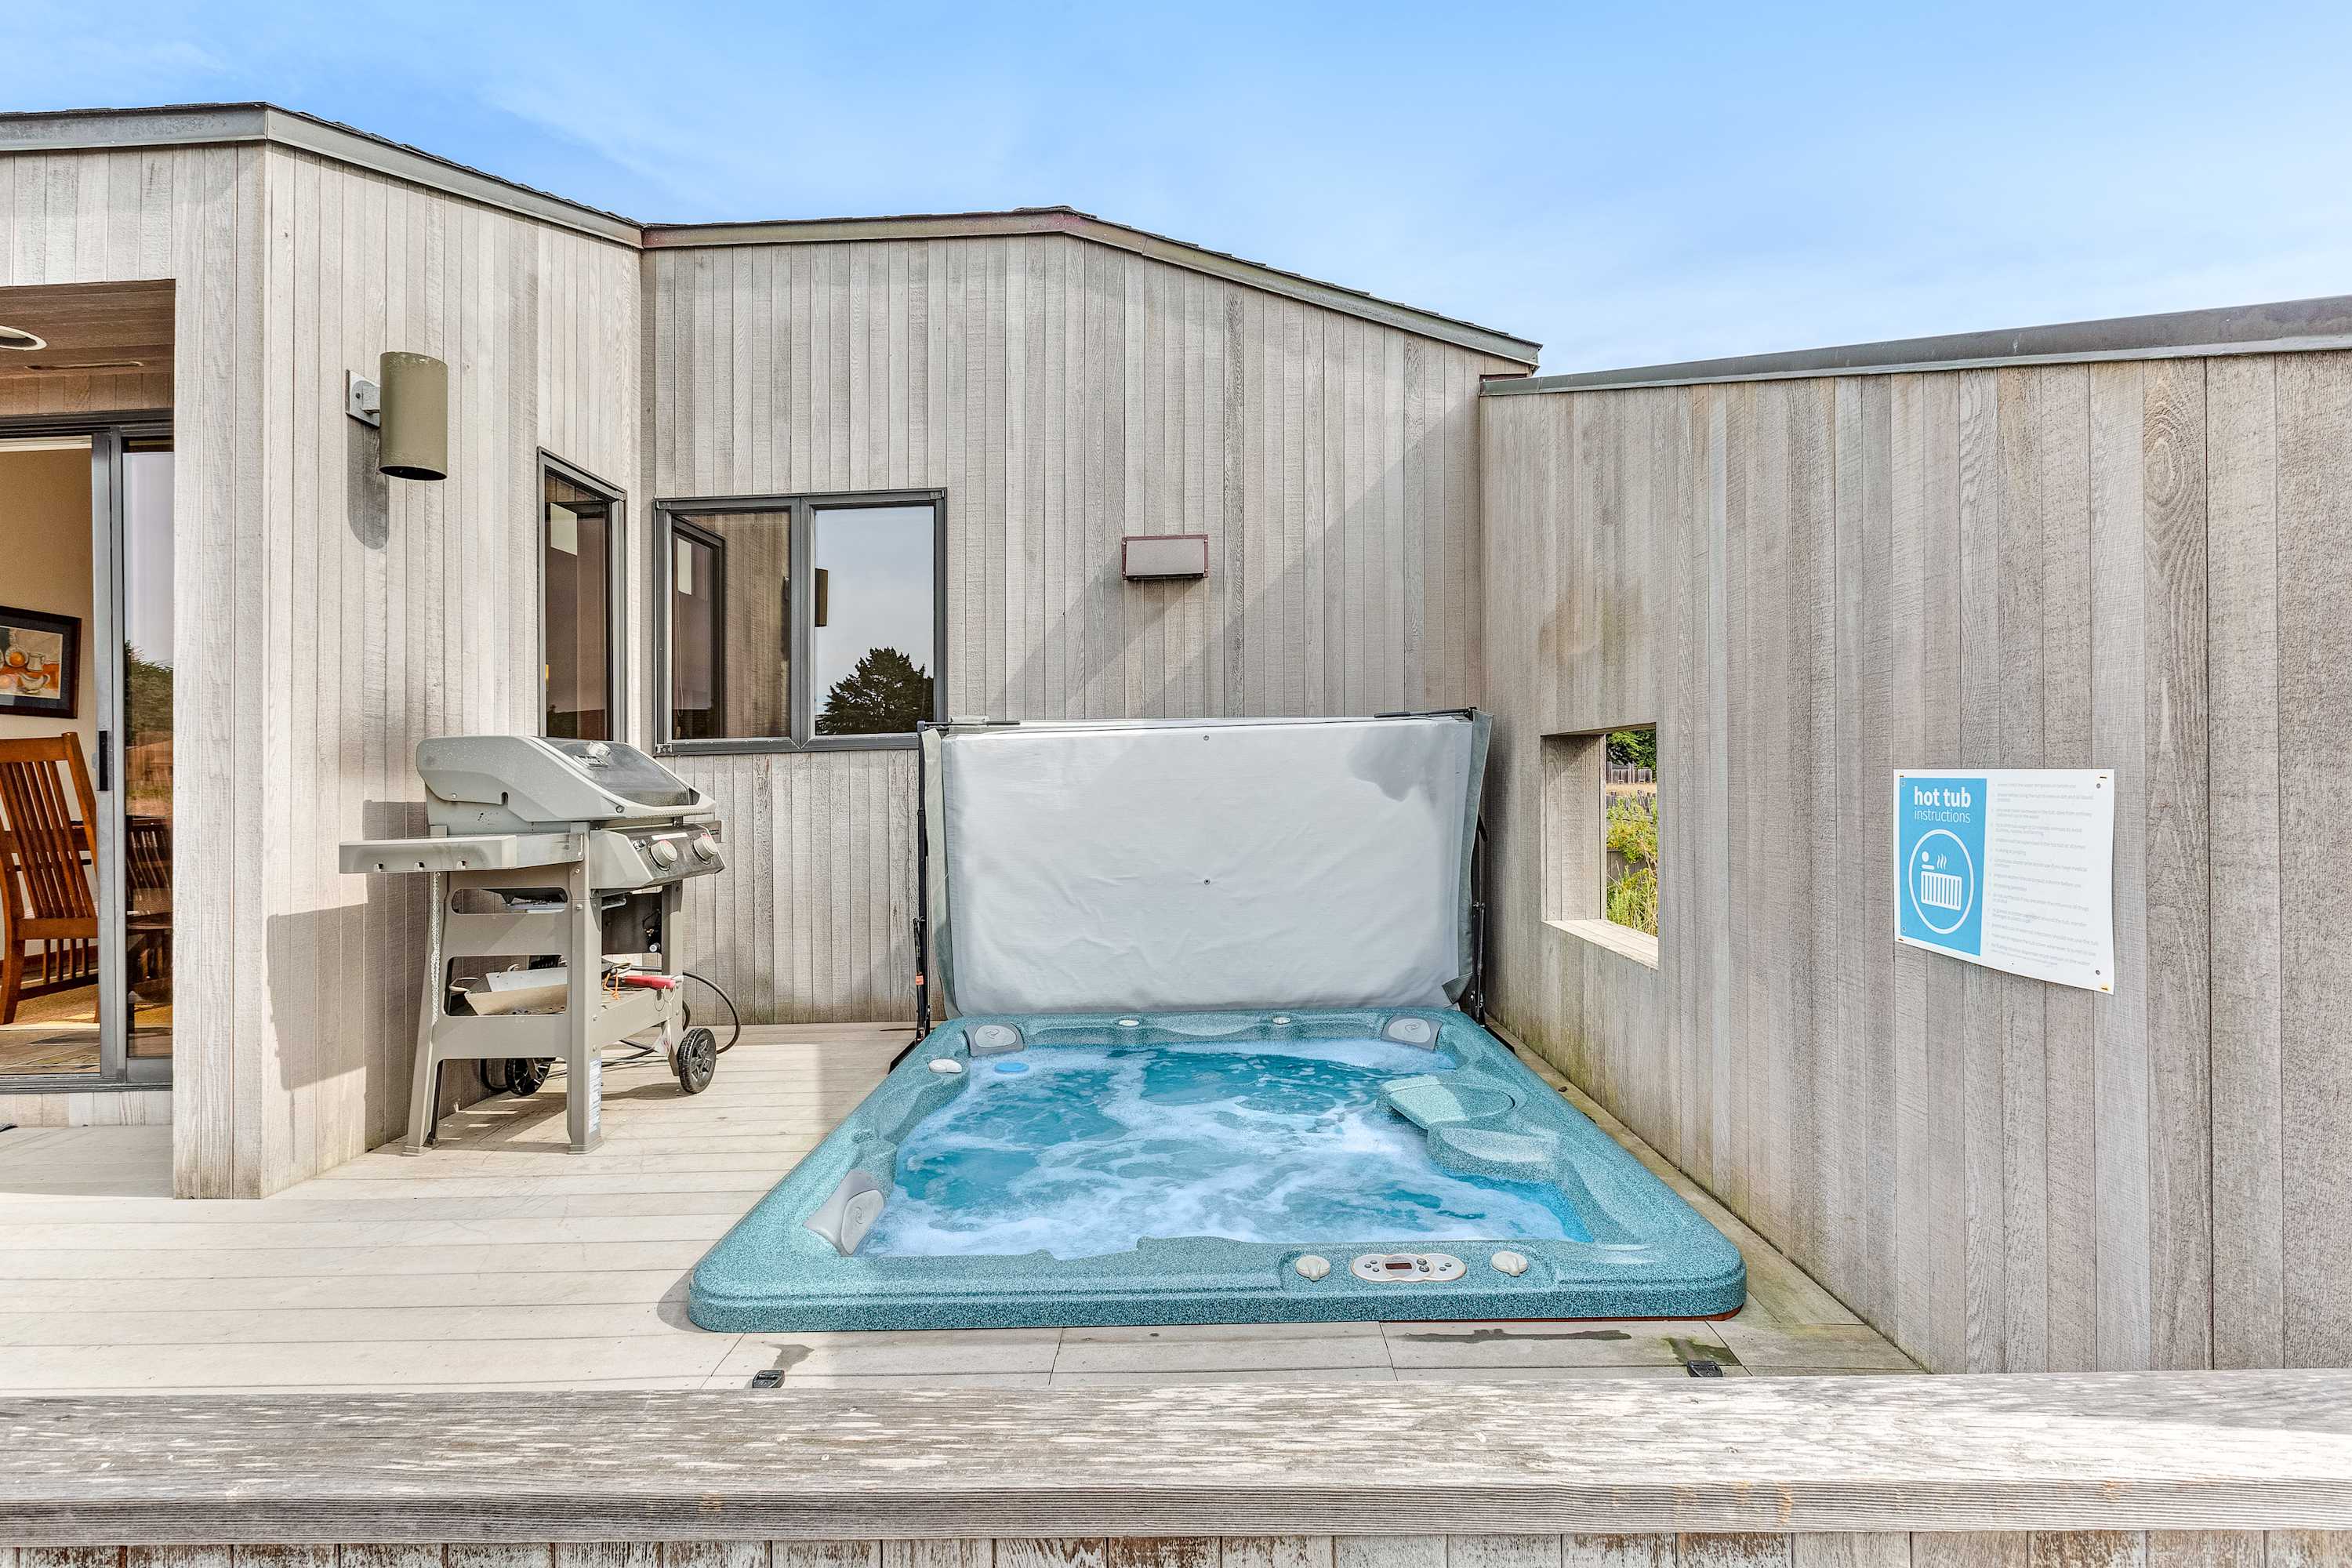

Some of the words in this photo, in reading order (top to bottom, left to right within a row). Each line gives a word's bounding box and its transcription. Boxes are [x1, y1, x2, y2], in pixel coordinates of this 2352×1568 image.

[1914, 786, 1940, 806] hot
[1943, 786, 1971, 808] tub
[1914, 807, 1971, 823] instructions
